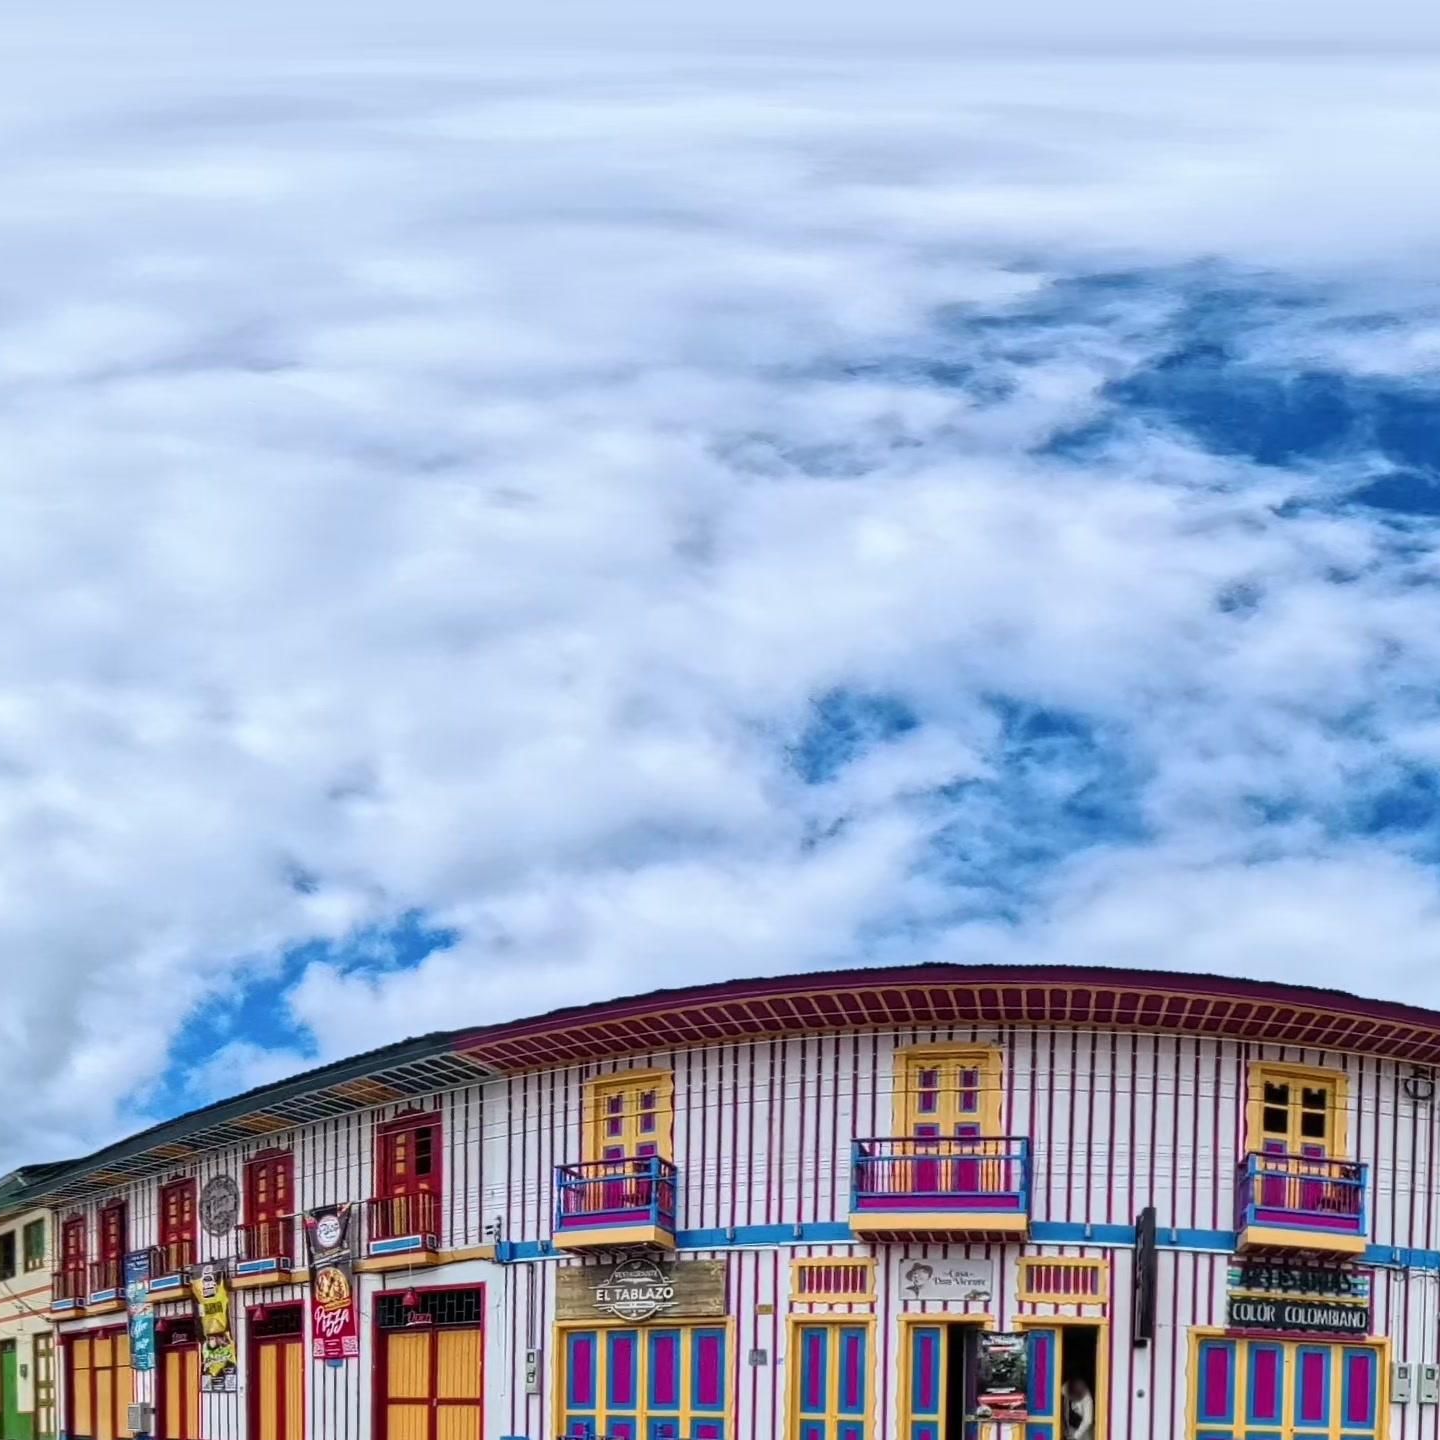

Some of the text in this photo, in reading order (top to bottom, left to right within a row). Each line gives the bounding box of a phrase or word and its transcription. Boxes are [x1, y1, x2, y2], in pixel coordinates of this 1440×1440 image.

[596, 1287, 674, 1301] EL TABLAZO
[314, 1305, 350, 1338] Pizza
[1284, 1305, 1366, 1328] COLOMBIANO
